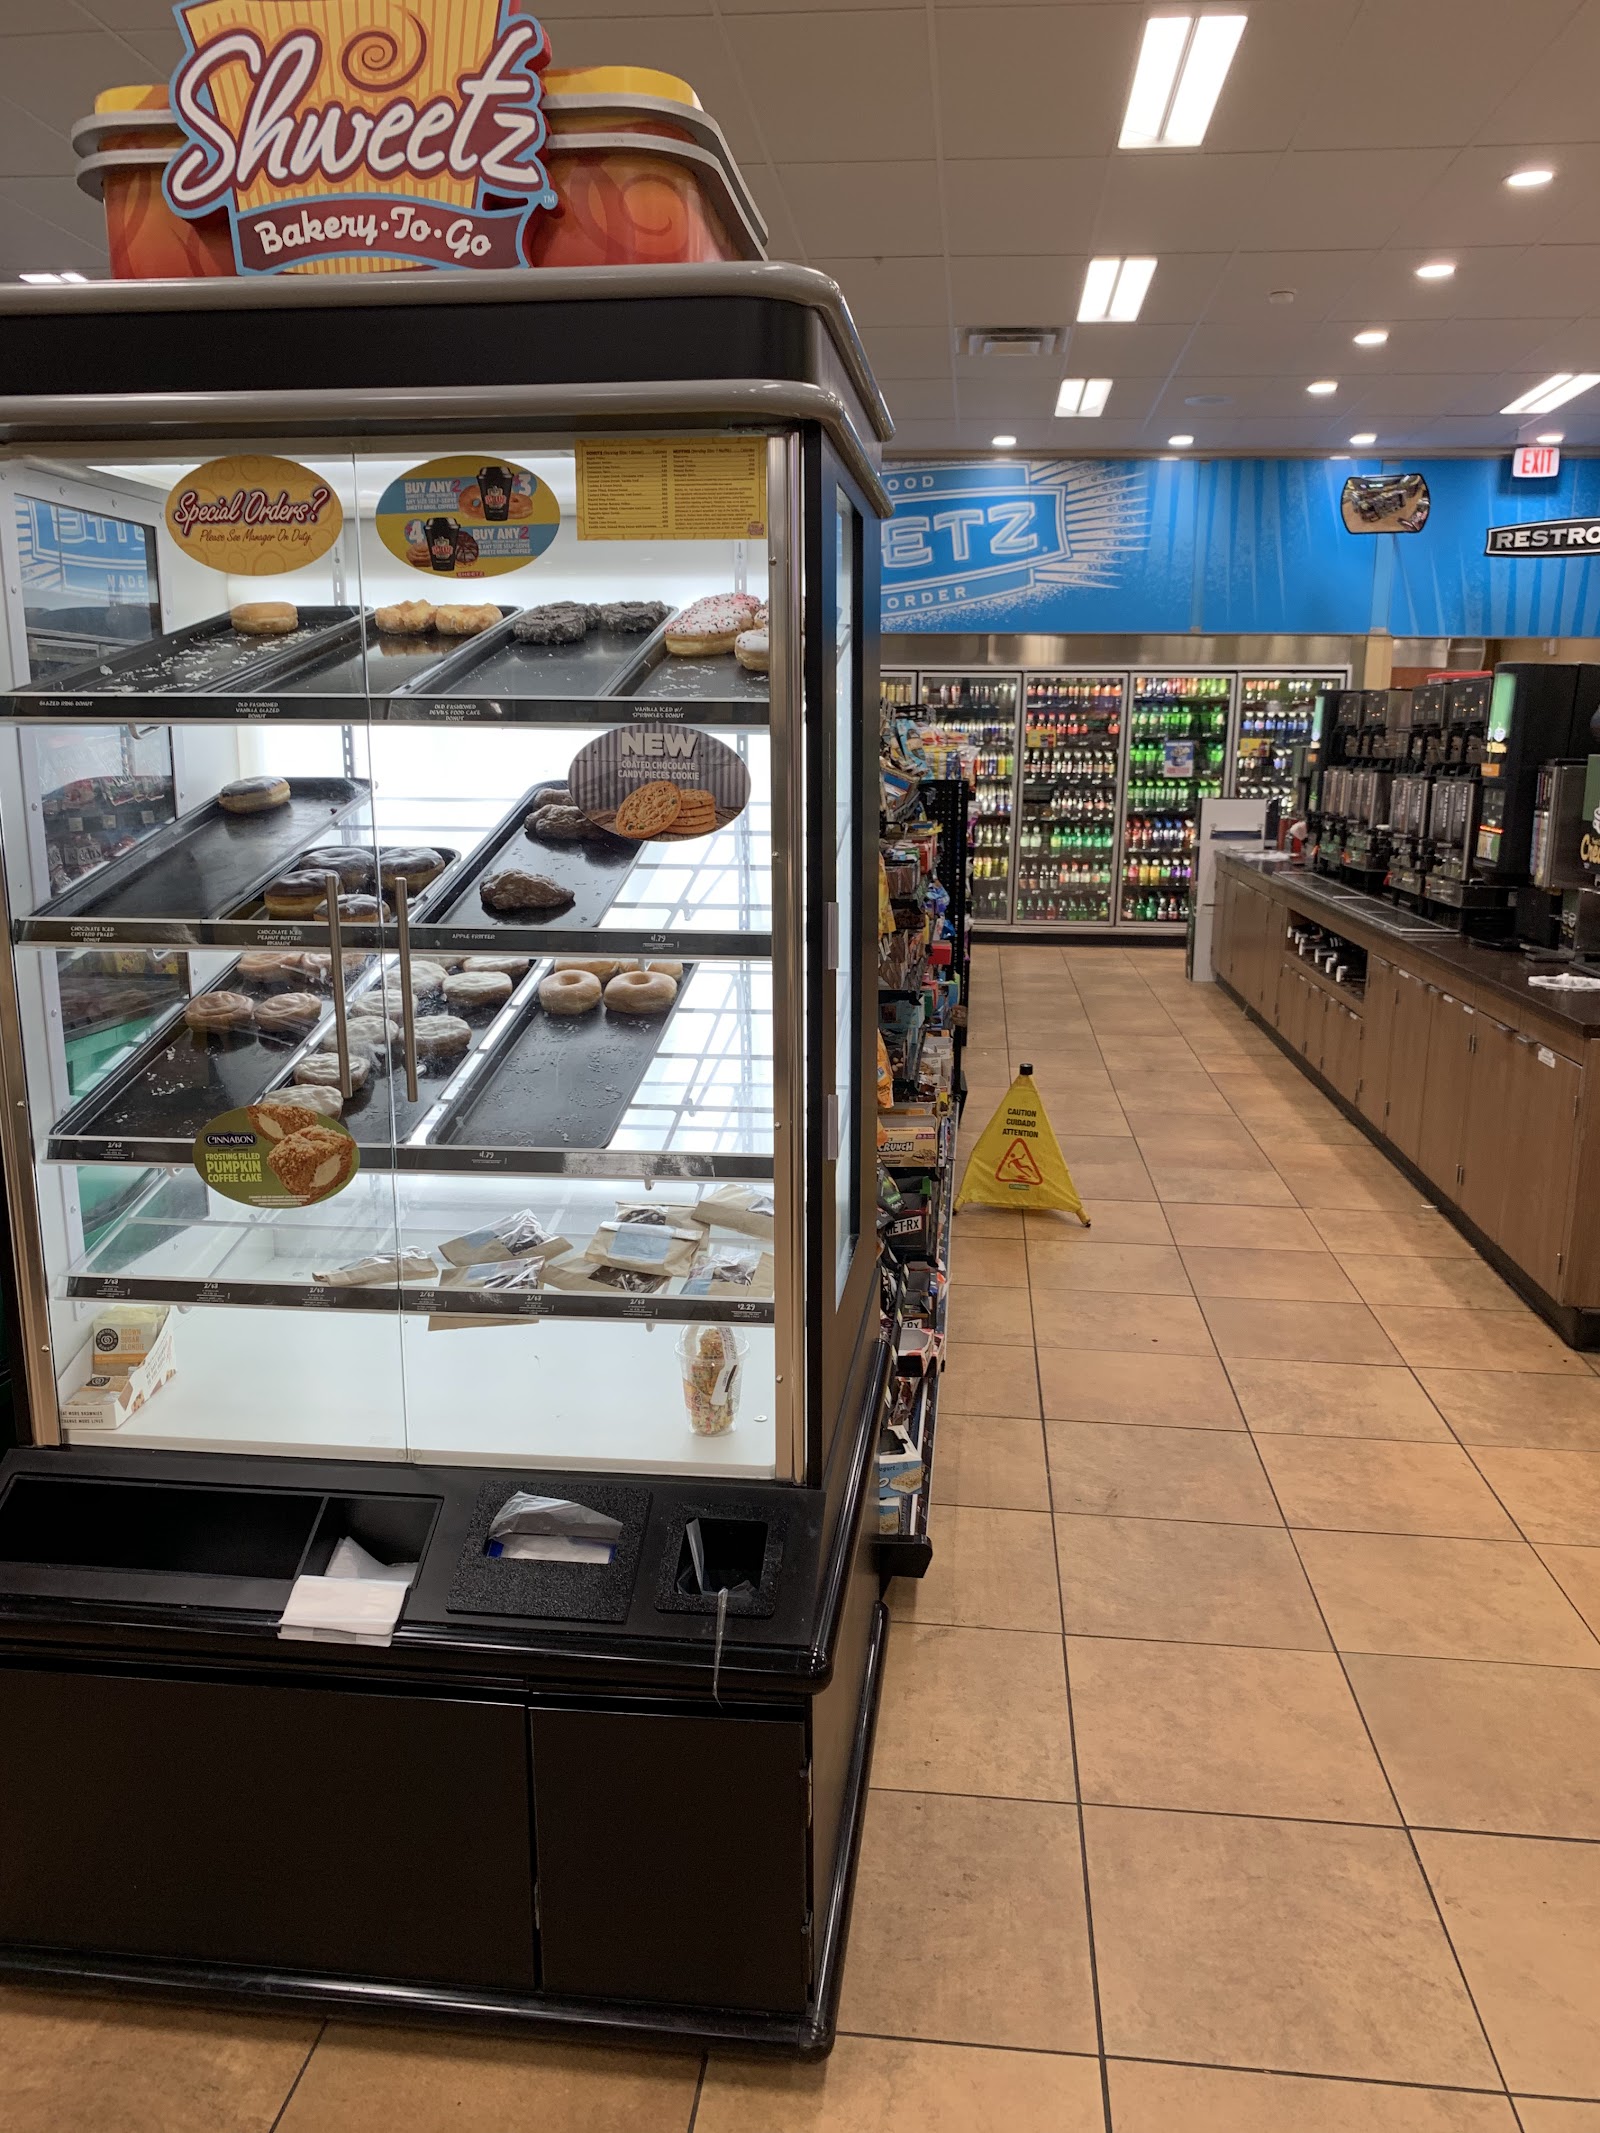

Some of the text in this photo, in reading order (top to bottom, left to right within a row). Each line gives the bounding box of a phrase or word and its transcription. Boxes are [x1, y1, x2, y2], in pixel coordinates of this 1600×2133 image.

[172, 26, 540, 203] Shweetz
[1521, 449, 1554, 474] EXIT
[404, 481, 426, 493] BUY
[174, 486, 330, 537] Special Orders?
[200, 530, 225, 542] Please
[226, 529, 241, 542] See
[242, 530, 275, 546] Manager
[277, 529, 289, 541] On
[472, 528, 494, 540] BUY
[1495, 526, 1600, 549] RESTRO
[107, 574, 144, 588] MADE
[887, 586, 966, 609] ORDER
[621, 732, 697, 758] NEW
[621, 761, 696, 771] COATED CHOCOLATE
[617, 770, 699, 780] CANDY PIECES COOKIE
[1007, 1108, 1037, 1117] CAUTION
[1006, 1118, 1036, 1128] CUIDADO
[1002, 1128, 1039, 1138] ATTENTION
[206, 1135, 254, 1145] CINNABON
[205, 1153, 238, 1161] FROSTING
[206, 1161, 262, 1173] PUMPKIN
[207, 1173, 262, 1183] COFFEE CAKE
[737, 1303, 756, 1311] $2.29
